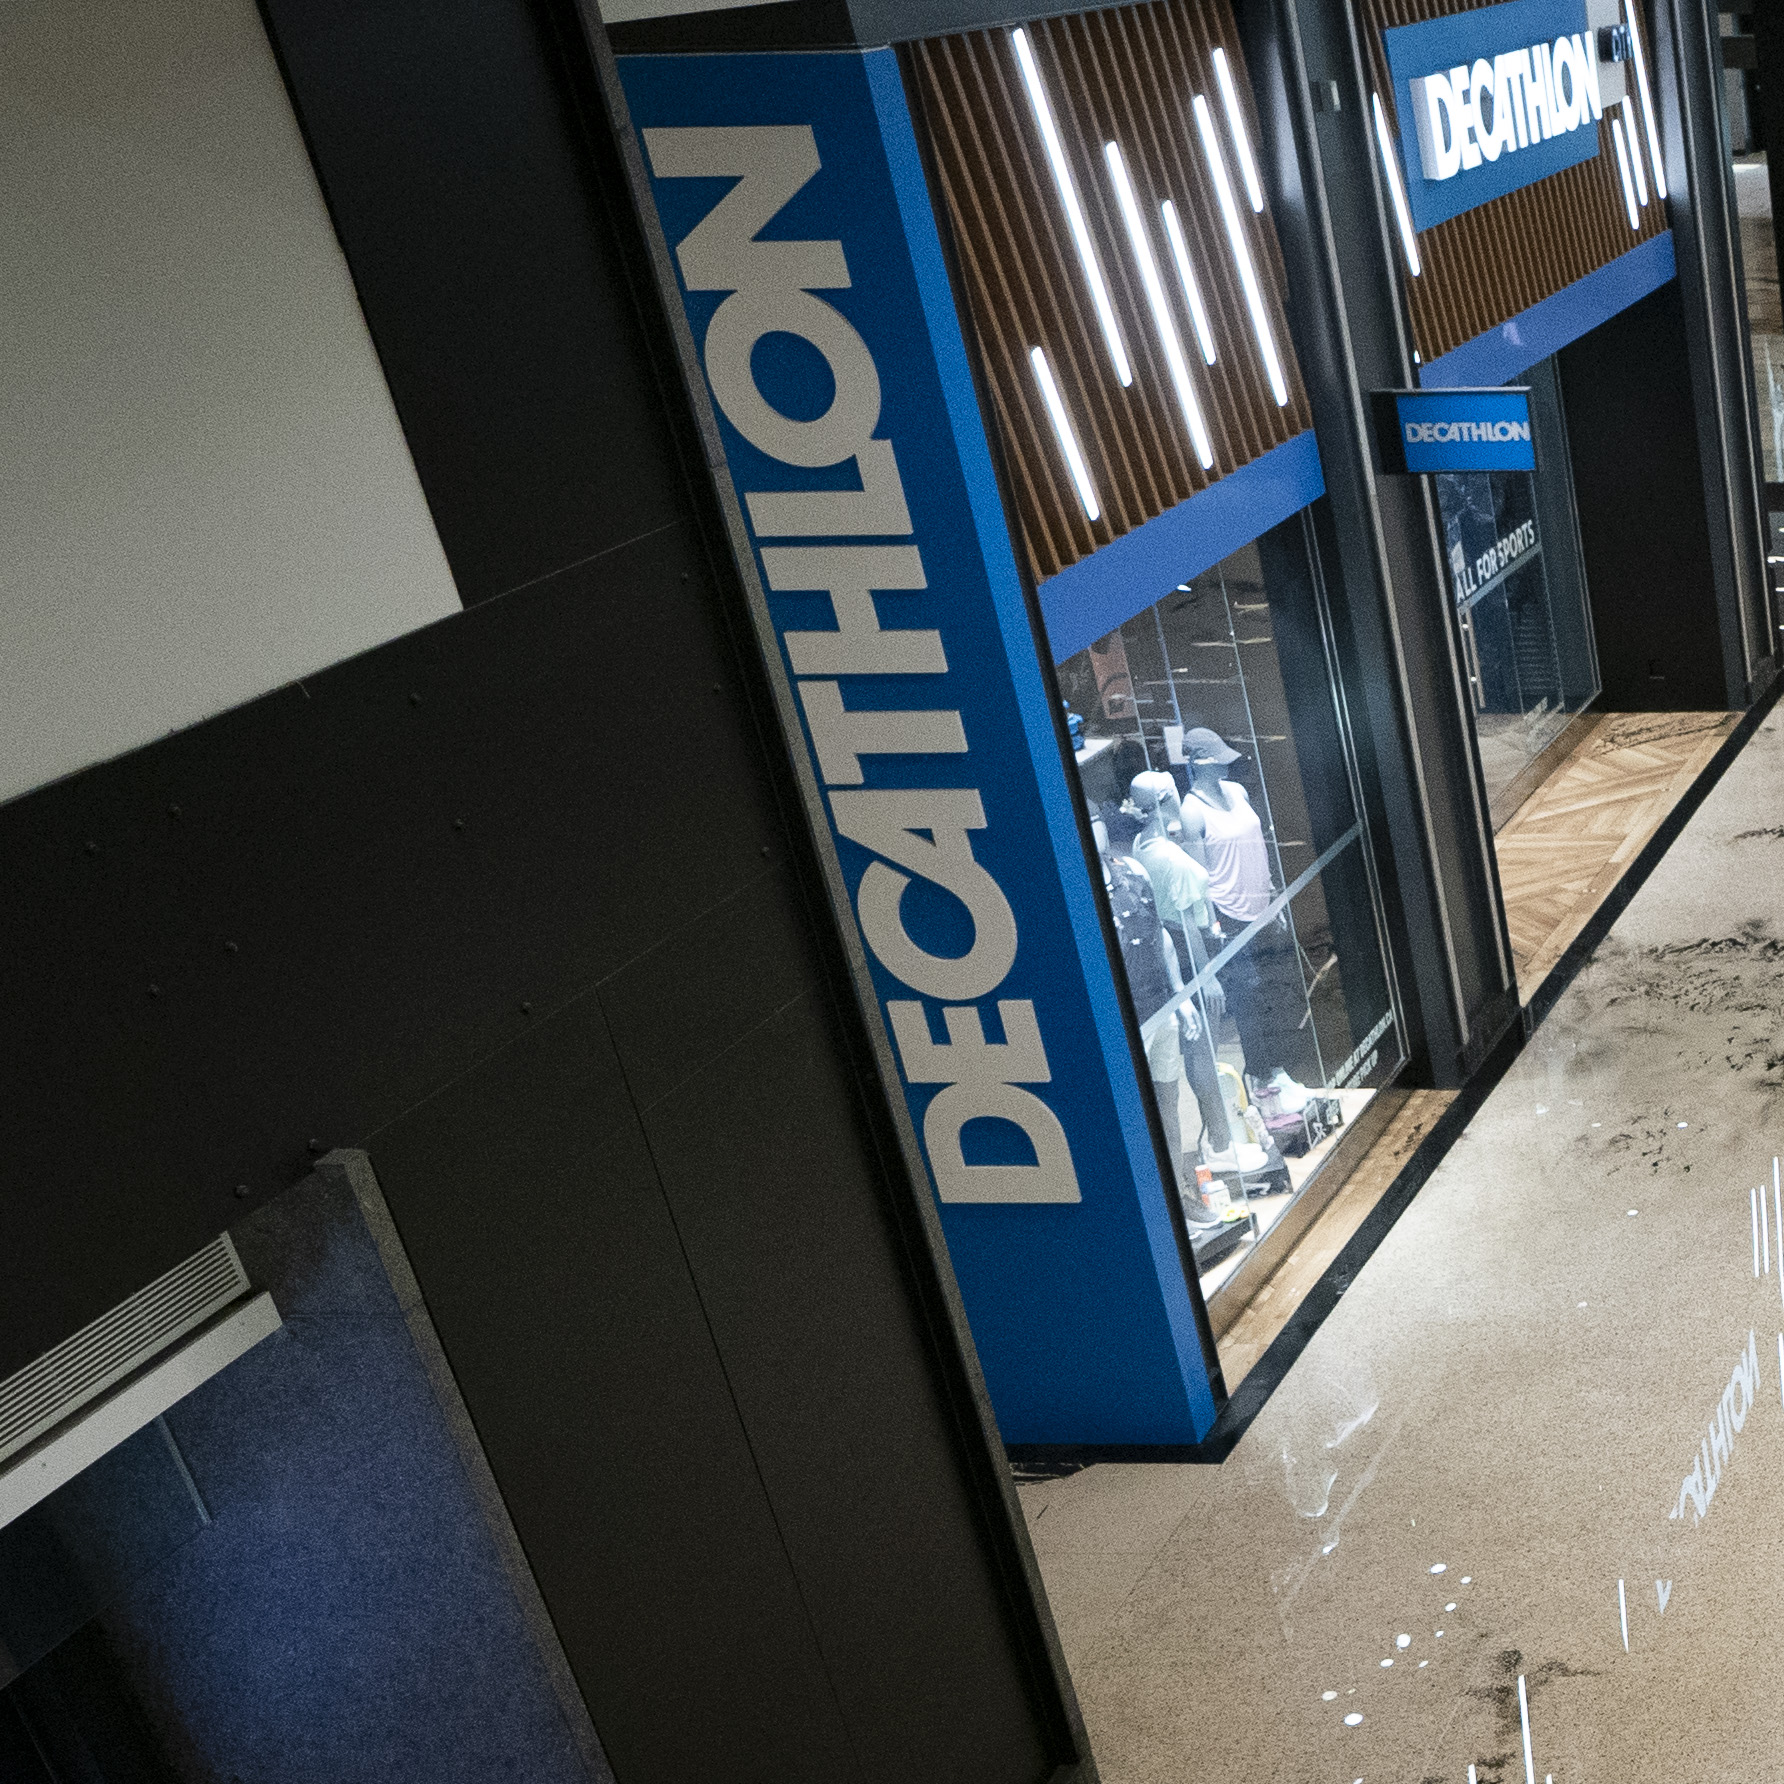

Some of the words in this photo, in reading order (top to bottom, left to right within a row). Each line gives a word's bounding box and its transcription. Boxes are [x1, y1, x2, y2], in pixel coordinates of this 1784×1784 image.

[1424, 31, 1602, 181] DECATHLON
[1405, 421, 1530, 443] DECATHLON
[1455, 567, 1477, 604] ALL
[1476, 548, 1499, 585] FOR
[1497, 519, 1535, 567] SPORTS
[641, 124, 1082, 1203] DECATHLON
